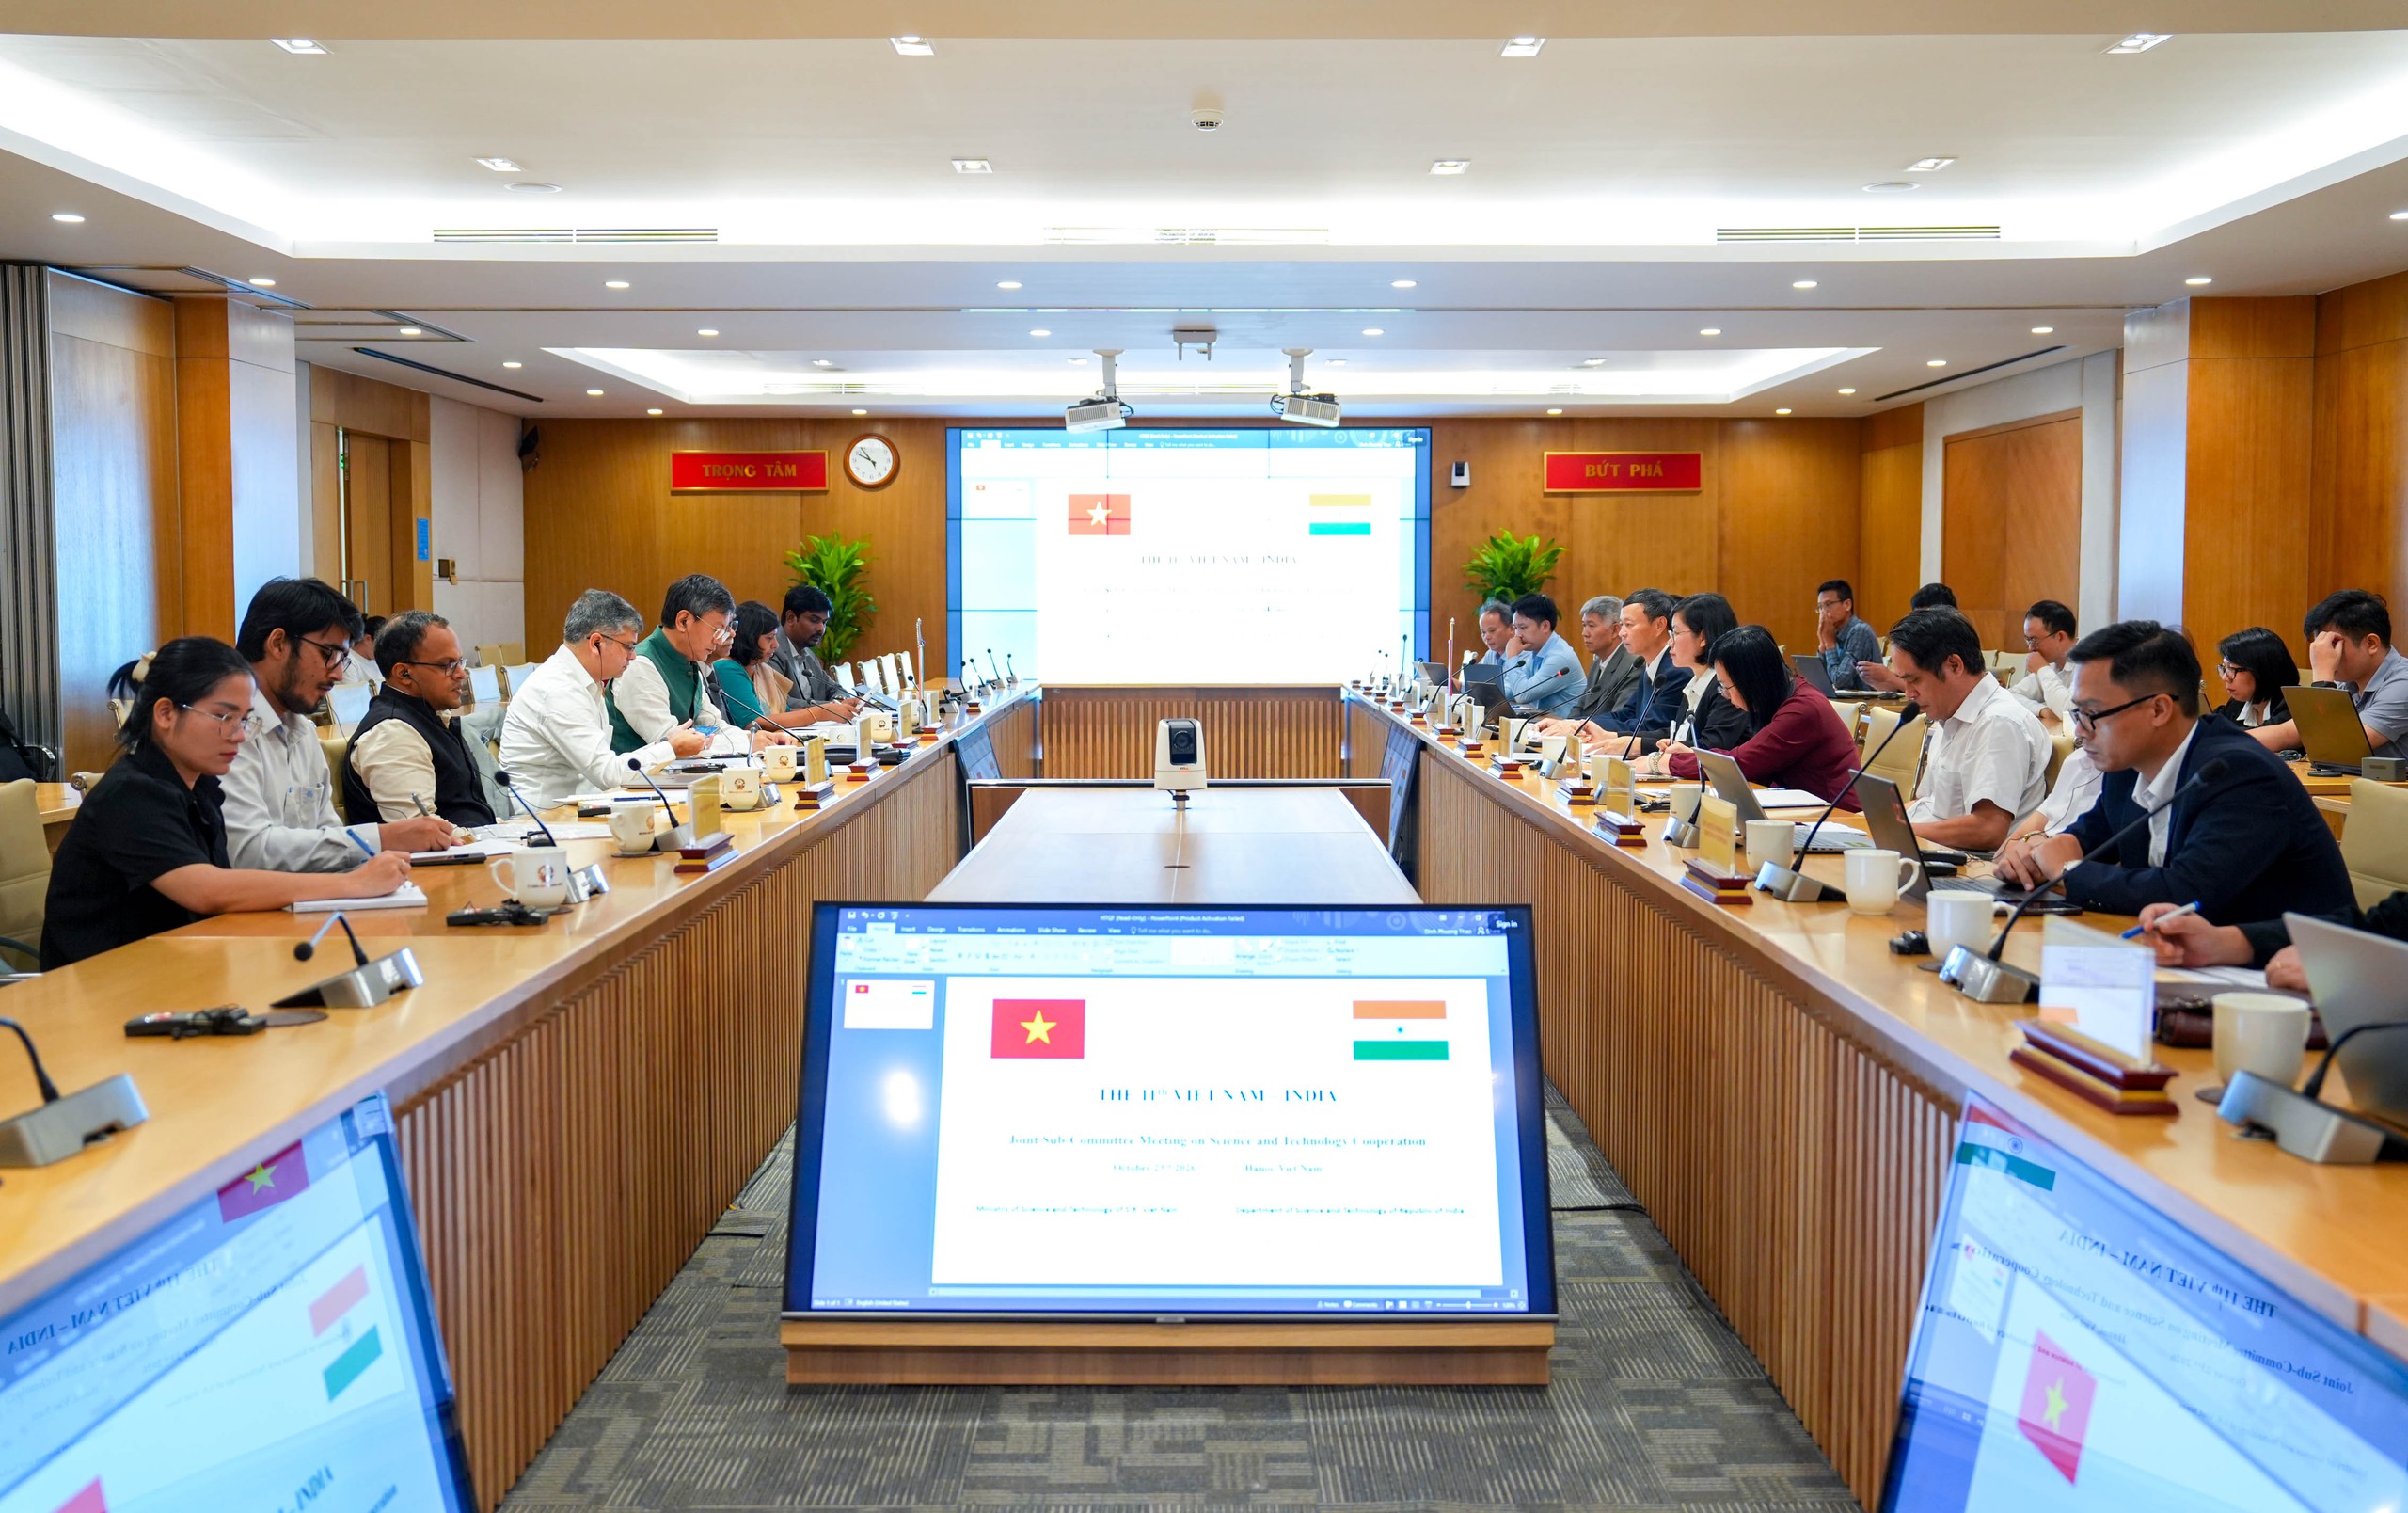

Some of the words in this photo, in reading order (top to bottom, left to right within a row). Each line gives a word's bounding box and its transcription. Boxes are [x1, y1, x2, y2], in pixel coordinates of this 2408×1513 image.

[702, 464, 757, 481] TRỌNG
[764, 460, 797, 477] TÂM
[1585, 459, 1621, 478] BỨT
[1629, 459, 1664, 477] PHÁ
[927, 926, 946, 934] Design
[1496, 920, 1511, 929] Sign
[1100, 1089, 1132, 1102] THE
[1285, 1089, 1338, 1102] INDIA
[1008, 1135, 1038, 1145] Joint
[1140, 1135, 1187, 1147] Meeting
[1191, 1137, 1205, 1145] on
[1210, 1135, 1252, 1145] Science
[1257, 1135, 1278, 1145] and
[1283, 1135, 1348, 1147] Technology
[1352, 1135, 1427, 1148] Cooperation
